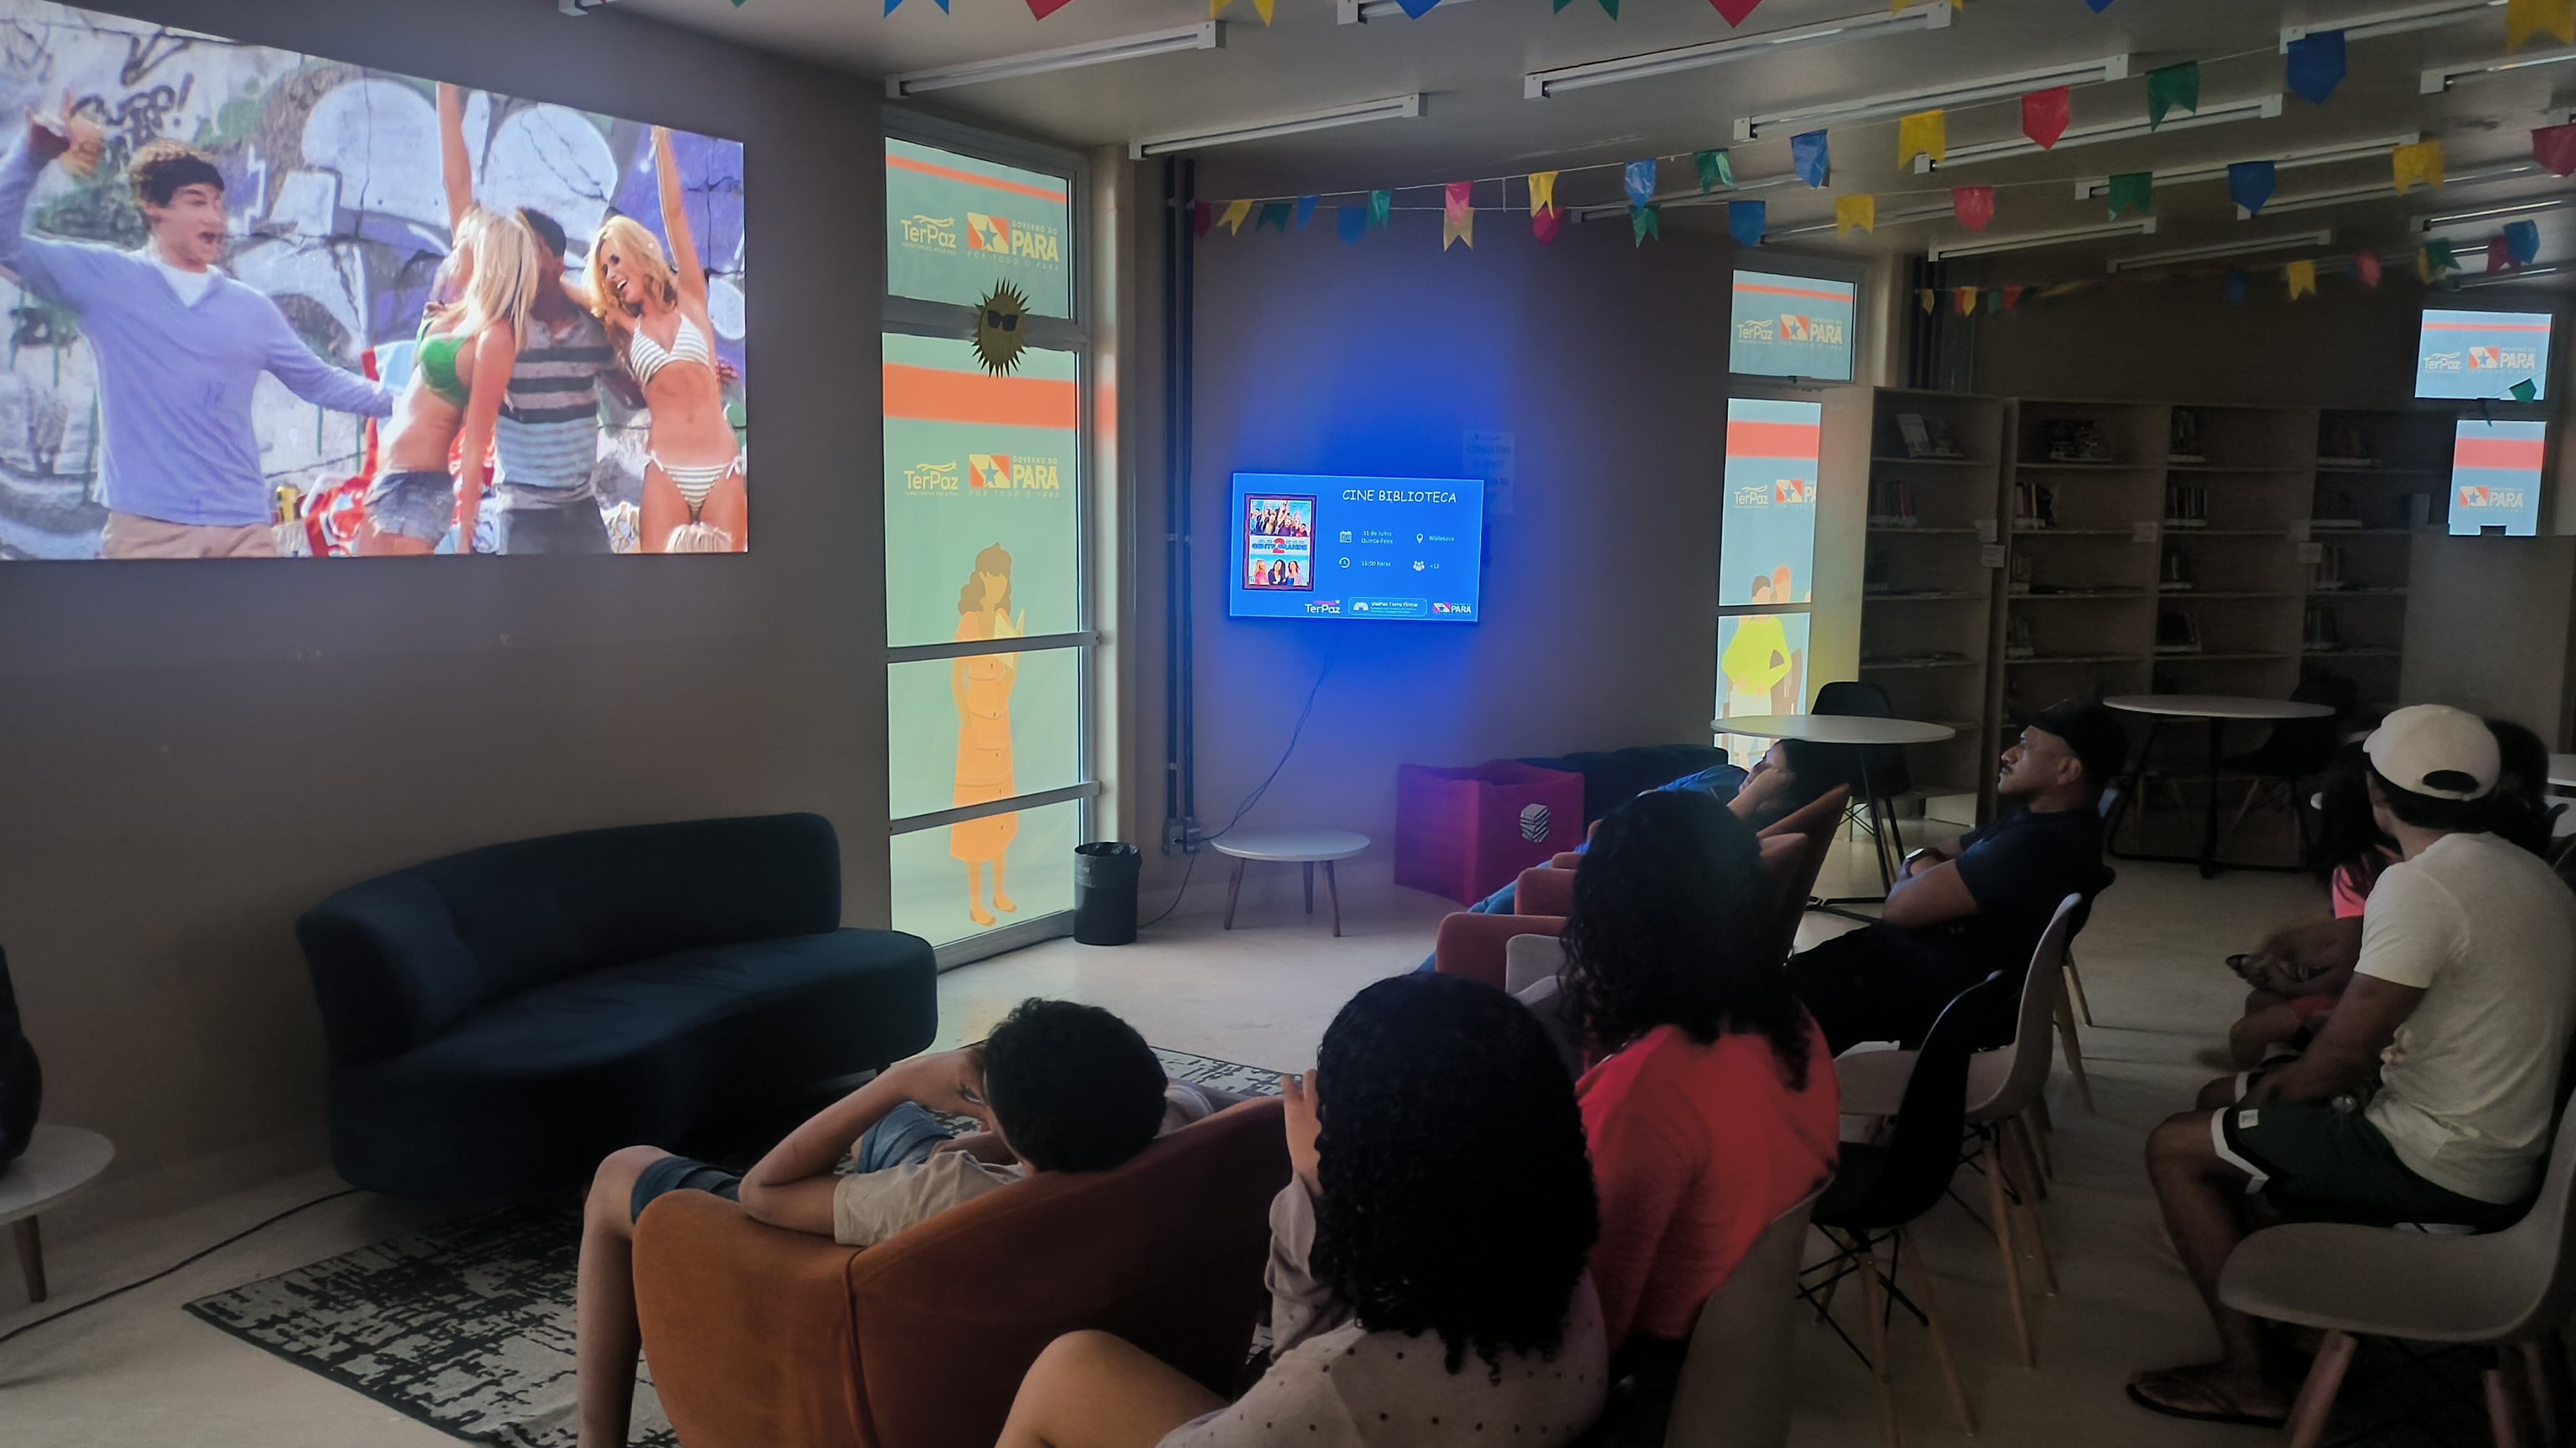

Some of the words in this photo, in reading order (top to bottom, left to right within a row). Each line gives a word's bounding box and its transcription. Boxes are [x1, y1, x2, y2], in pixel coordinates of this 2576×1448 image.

[900, 219, 956, 248] TerPaz
[1737, 324, 1773, 340] TerPaz
[2423, 357, 2461, 370] TerPaz
[1012, 455, 1046, 464] GOVERNO
[903, 470, 959, 491] TerPaz
[1342, 490, 1375, 501] CINE
[1378, 490, 1456, 503] BIBLIOTECA
[1734, 491, 1769, 505] TerPaz
[1305, 603, 1341, 614] TerPaz
